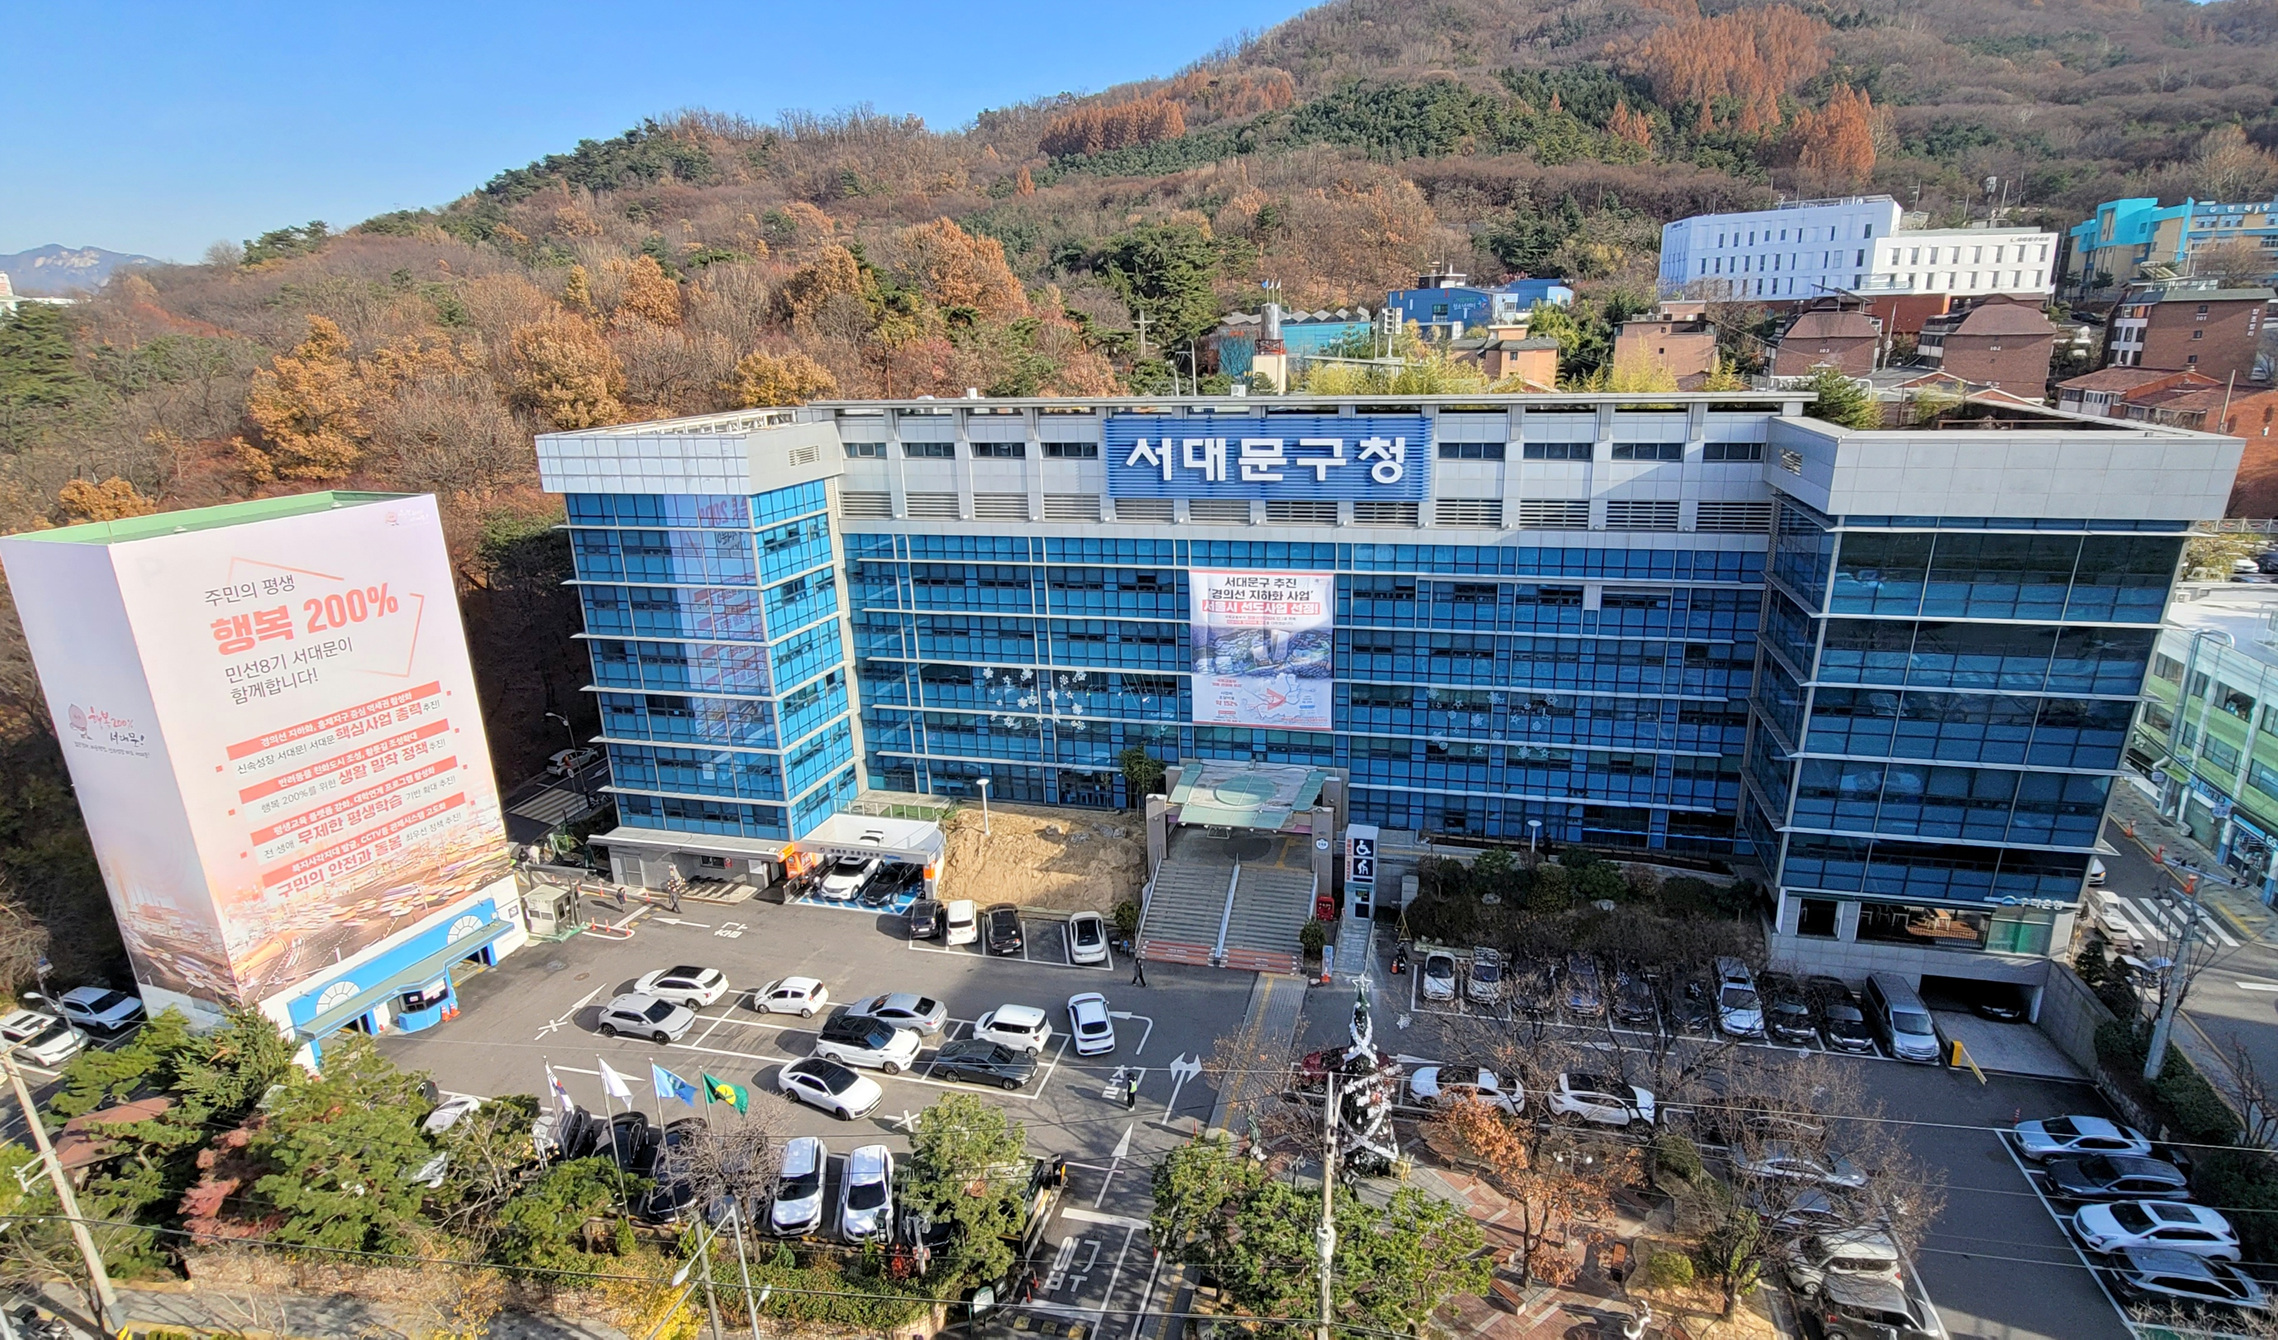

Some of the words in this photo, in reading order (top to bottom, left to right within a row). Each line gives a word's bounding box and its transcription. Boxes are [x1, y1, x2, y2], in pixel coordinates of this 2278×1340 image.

[1126, 437, 1405, 484] 서대문구청
[204, 582, 258, 607] 주민의
[261, 574, 295, 597] 평생
[1225, 577, 1270, 588] 서대문구
[1273, 578, 1297, 589] 추진
[1249, 590, 1284, 601] 지하화
[210, 604, 294, 656] 행복
[303, 582, 399, 634] 200%
[1203, 601, 1238, 612] 서울시
[1241, 602, 1288, 614] 선도사업
[225, 653, 287, 684] 민선8기
[292, 636, 353, 665] 서대문이
[230, 667, 319, 705] 함께합니다!
[237, 754, 275, 775] 신속성장
[309, 734, 336, 750] 서대문
[335, 711, 392, 740] 핵심사업
[395, 702, 423, 722] 총력
[338, 763, 368, 786] 생활
[370, 751, 399, 774] 밀착
[402, 740, 429, 762] 정책
[298, 817, 344, 844] 무제한
[346, 794, 403, 826] 평생학습
[277, 868, 325, 898] 구민의
[328, 848, 372, 877] 안전과
[2020, 897, 2065, 911] 우리은행
[1044, 1236, 1101, 1293] 입구
